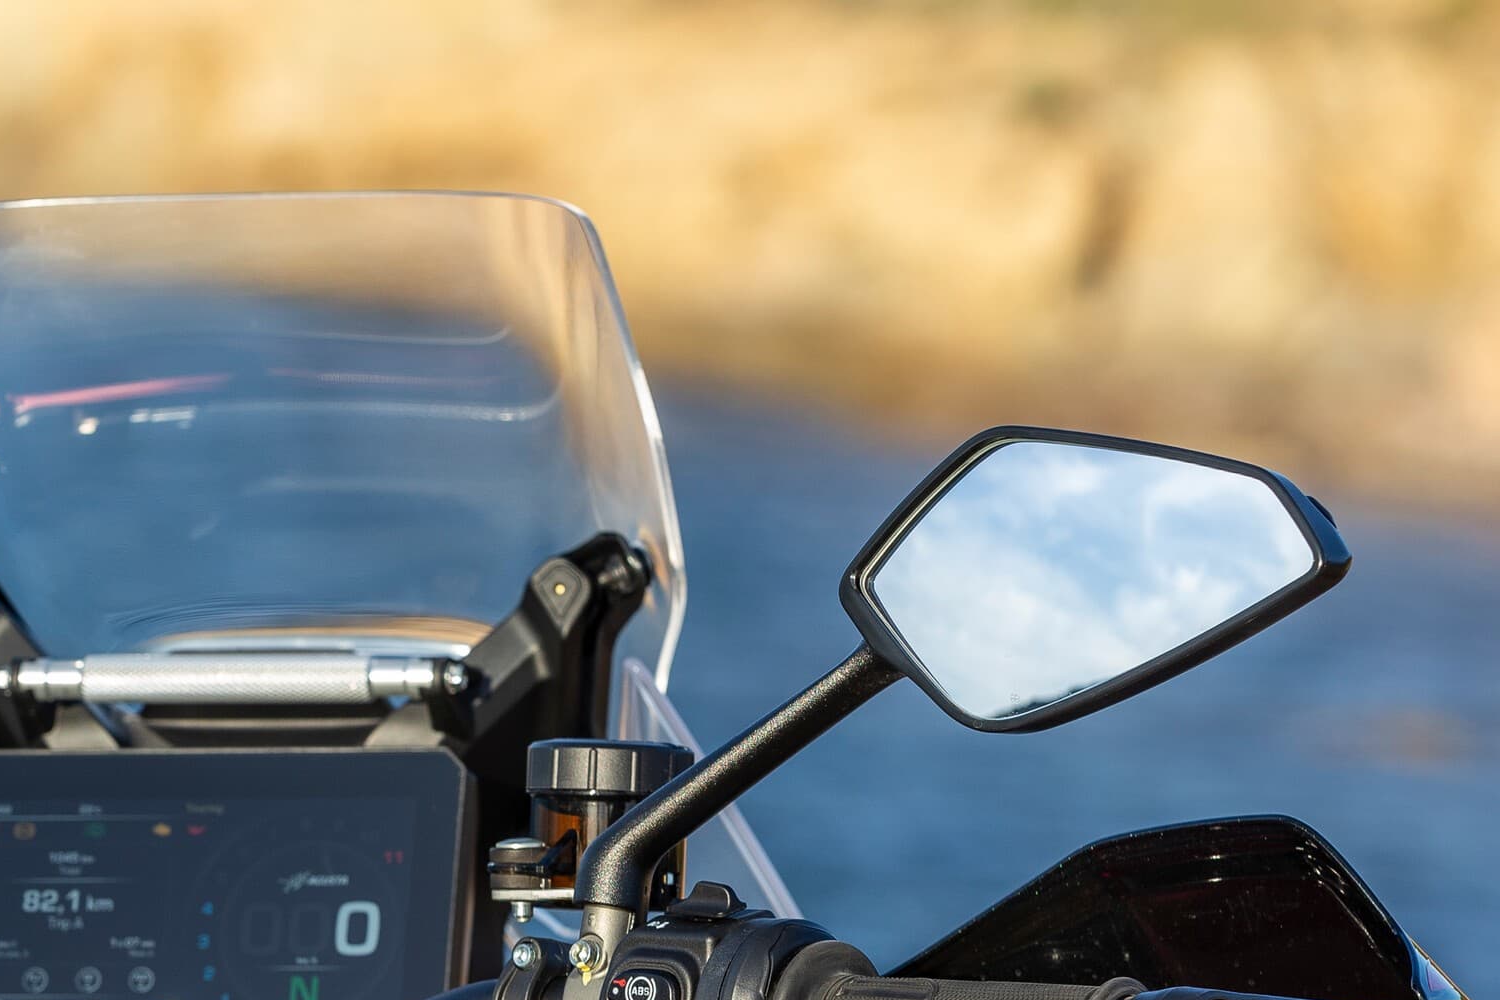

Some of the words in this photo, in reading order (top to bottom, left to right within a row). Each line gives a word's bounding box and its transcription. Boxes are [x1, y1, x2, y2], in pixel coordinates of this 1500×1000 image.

[86, 895, 115, 911] km
[198, 934, 211, 949] 3
[631, 986, 650, 997] ABS
